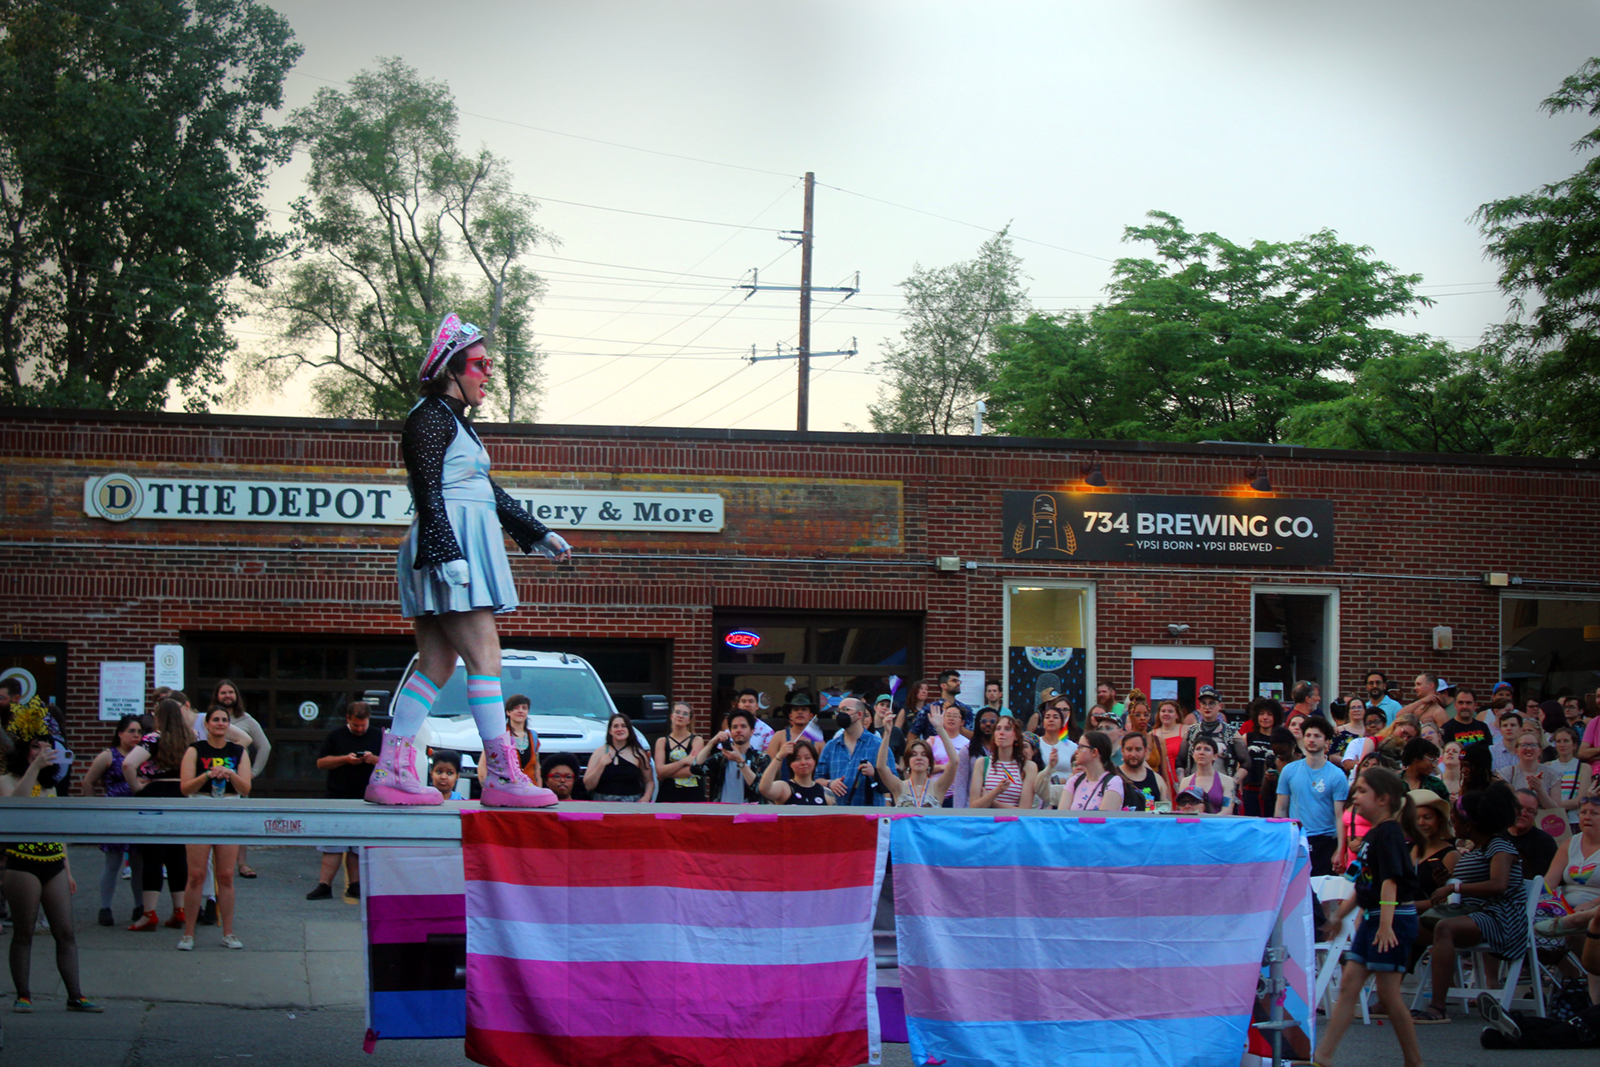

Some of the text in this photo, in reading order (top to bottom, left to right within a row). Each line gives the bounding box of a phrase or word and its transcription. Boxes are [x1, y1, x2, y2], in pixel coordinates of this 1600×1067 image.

[106, 485, 132, 509] D
[148, 483, 236, 516] THE
[247, 486, 392, 519] DEPOT
[598, 501, 622, 521] &
[633, 502, 714, 523] More
[1083, 511, 1319, 538] 734 BREWING CO.
[1136, 540, 1273, 552] YPSI BORN YPSI BREWED
[725, 634, 761, 647] OPEN
[1543, 820, 1564, 830] plum
